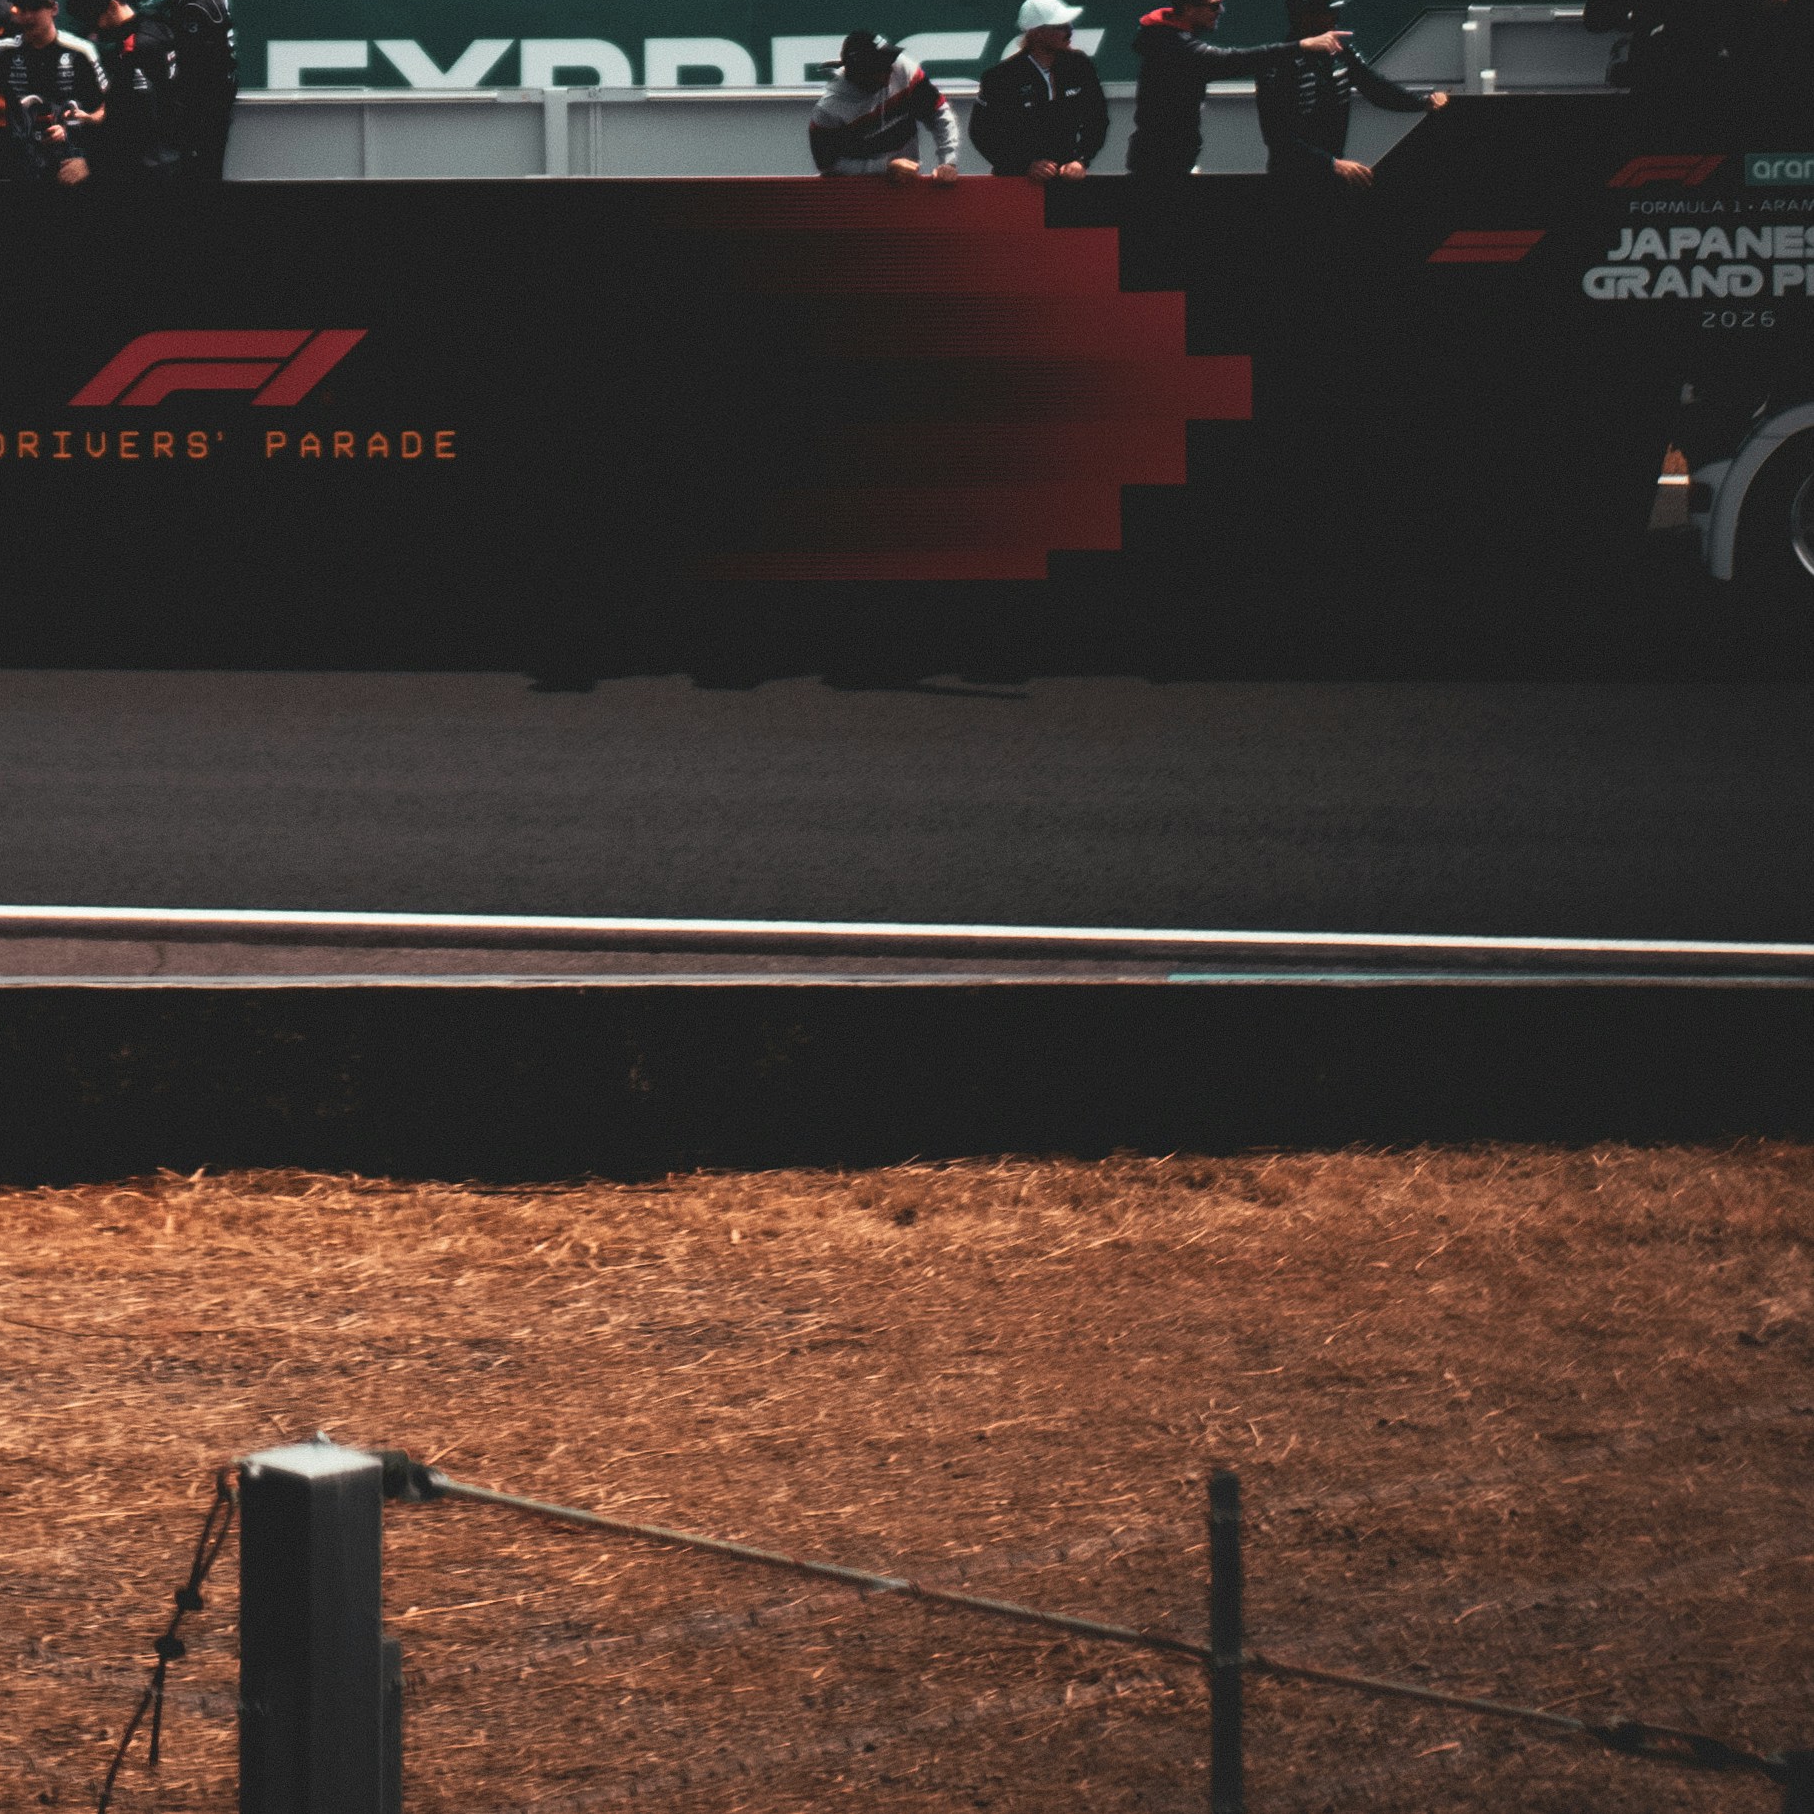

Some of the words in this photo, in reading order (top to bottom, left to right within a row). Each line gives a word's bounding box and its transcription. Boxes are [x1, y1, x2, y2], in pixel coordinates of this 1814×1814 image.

[1629, 201, 1724, 215] FORMULA
[1733, 200, 1741, 213] 1
[1582, 265, 1765, 300] GRAND
[1772, 264, 1814, 297] P
[1701, 310, 1777, 329] 2026
[67, 329, 369, 406] F1
[265, 430, 457, 459] PARADE
